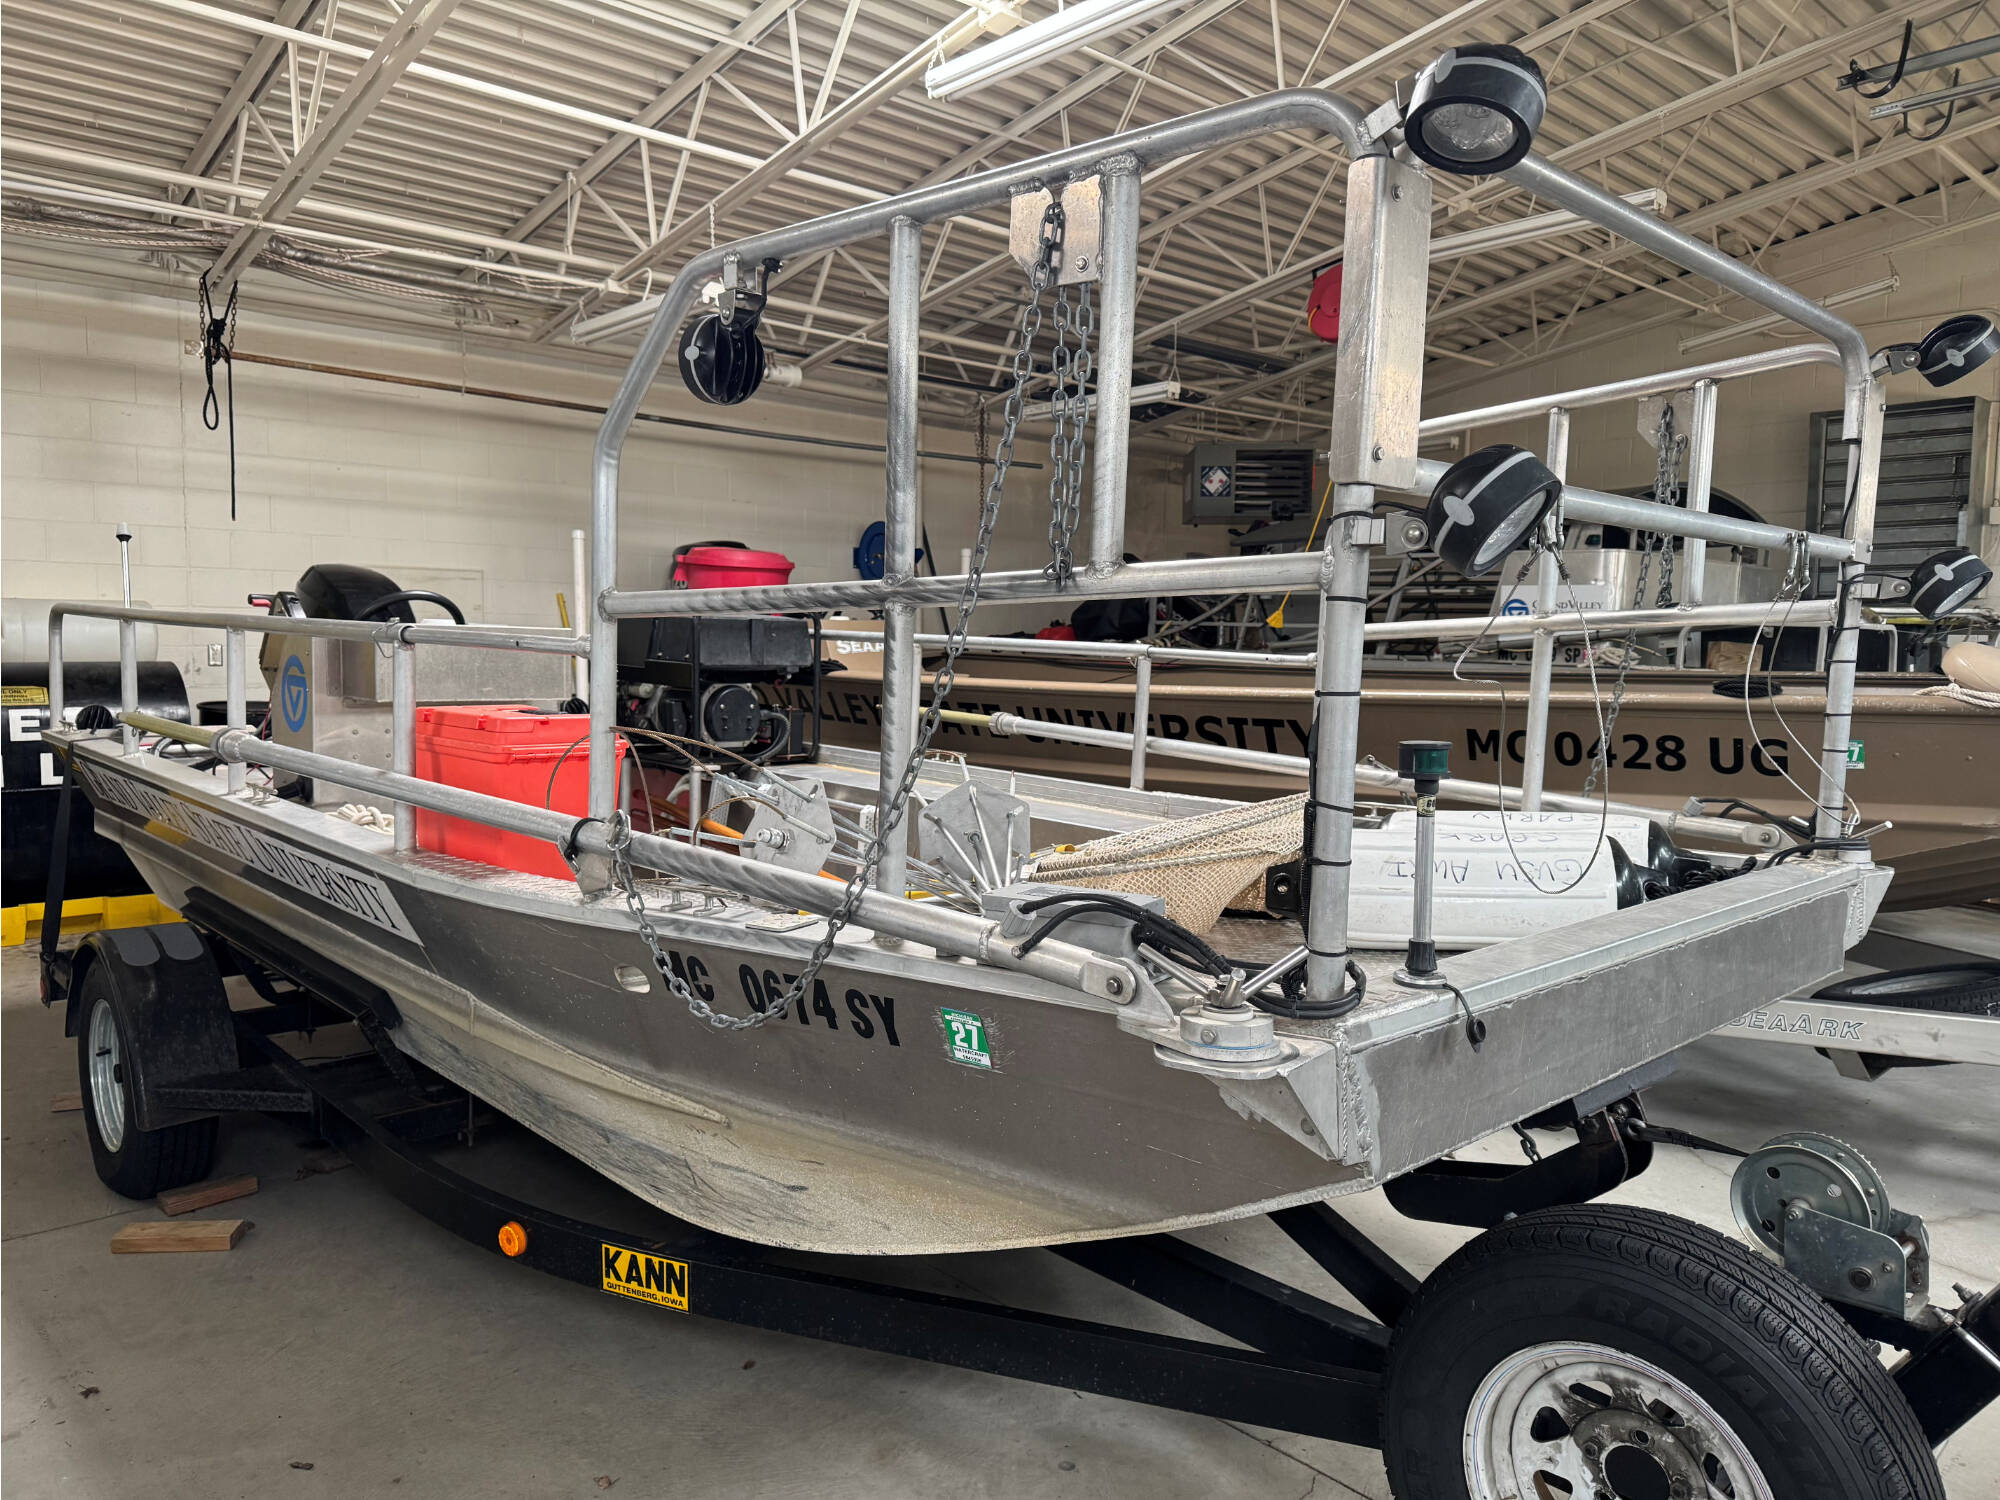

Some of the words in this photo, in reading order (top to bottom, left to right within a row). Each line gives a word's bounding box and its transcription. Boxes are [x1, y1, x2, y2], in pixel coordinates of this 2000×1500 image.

[1564, 647, 1580, 663] SP
[1466, 728, 1528, 765] MC
[1553, 730, 1688, 772] 0428
[1708, 736, 1789, 777] UG
[245, 828, 401, 931] UNIVERSITY
[1383, 858, 1469, 885] AWI
[656, 948, 715, 1002] MC
[738, 963, 839, 1031] 0674
[844, 987, 901, 1047] SY
[950, 1021, 979, 1051] 27
[604, 1246, 686, 1298] KANN
[606, 1281, 661, 1303] GUTTENBERG,
[661, 1295, 684, 1307] IOWA
